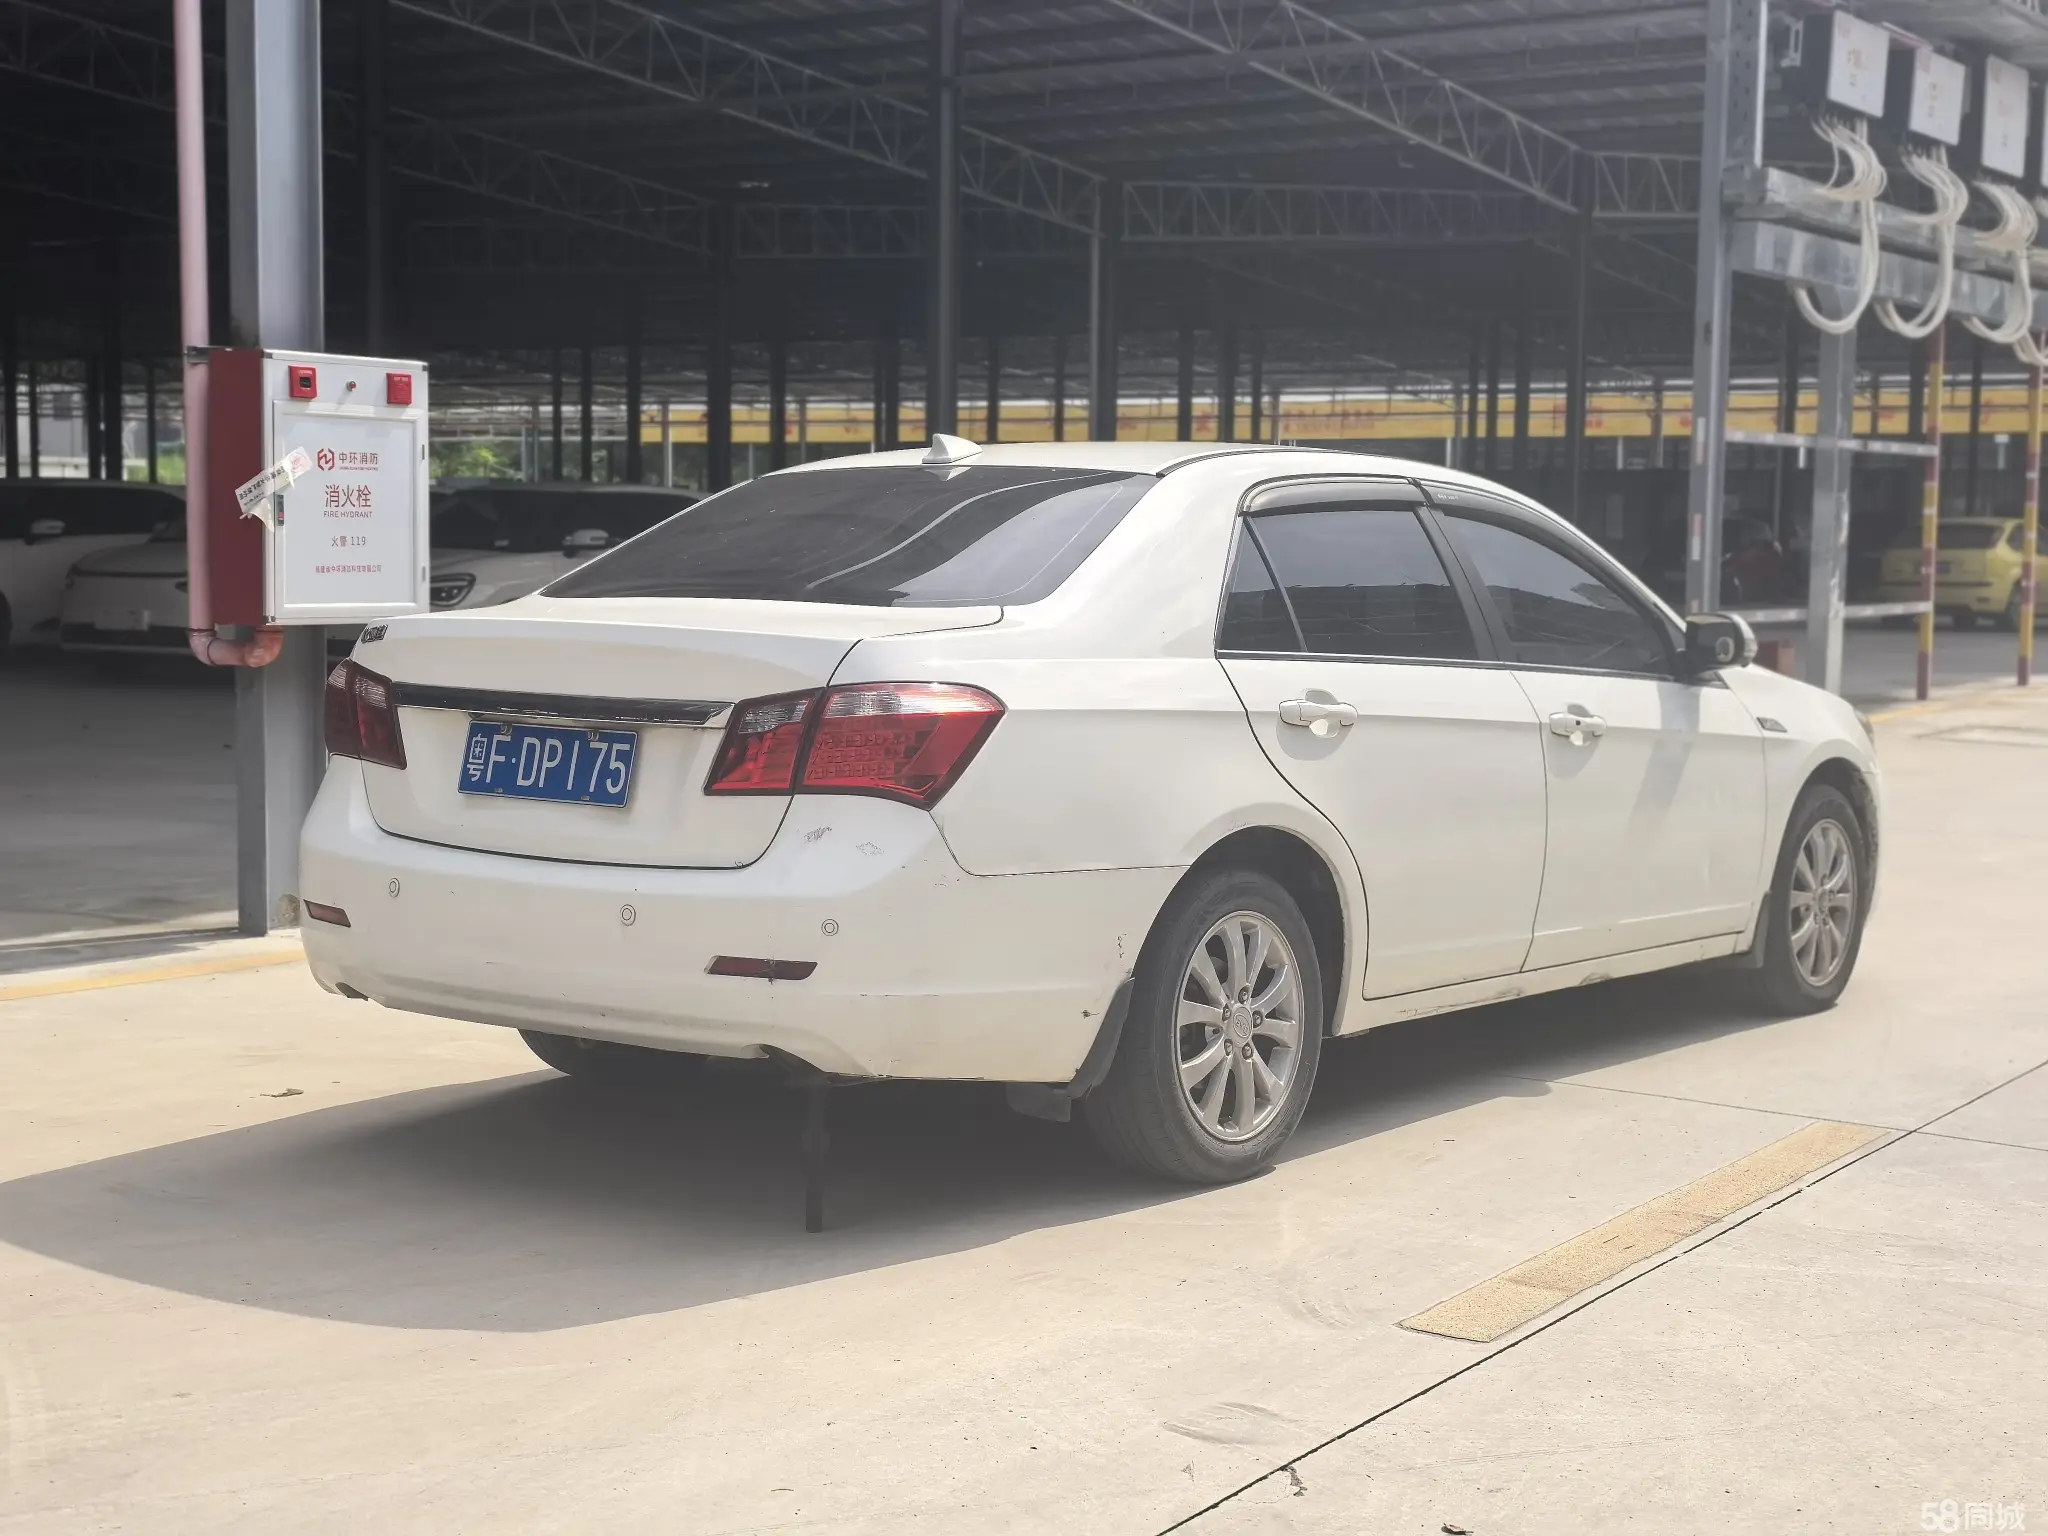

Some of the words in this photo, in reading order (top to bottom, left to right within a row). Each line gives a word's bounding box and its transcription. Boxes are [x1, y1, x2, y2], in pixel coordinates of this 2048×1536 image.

[339, 452, 379, 465] 中环消防
[325, 484, 371, 508] 消火栓
[324, 510, 339, 518] FIRE
[341, 511, 373, 519] HYDRANT
[351, 536, 366, 546] 119
